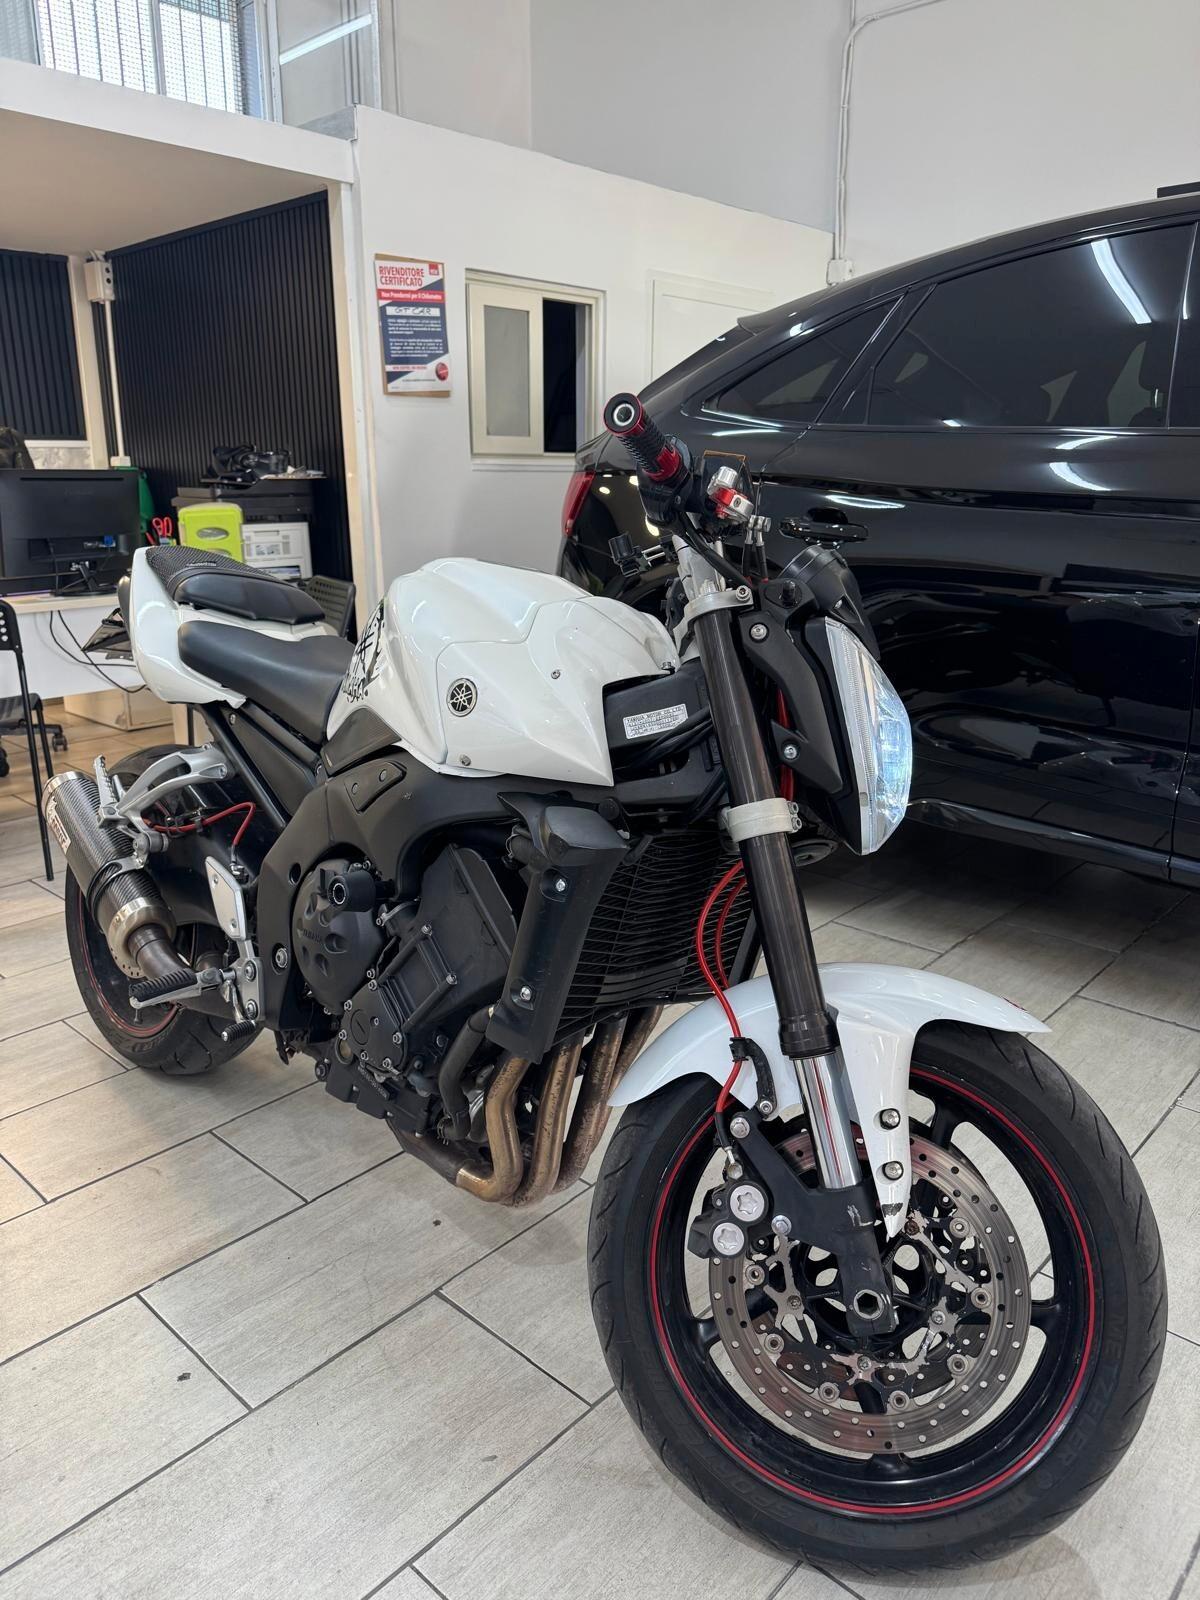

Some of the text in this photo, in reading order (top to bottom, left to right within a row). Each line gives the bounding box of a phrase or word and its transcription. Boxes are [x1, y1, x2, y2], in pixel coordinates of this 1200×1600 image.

[379, 266, 424, 277] RIVENDITORE
[380, 276, 423, 287] CERTIFICATO
[412, 307, 431, 315] CAR
[1054, 1312, 1127, 1468] METZELER
